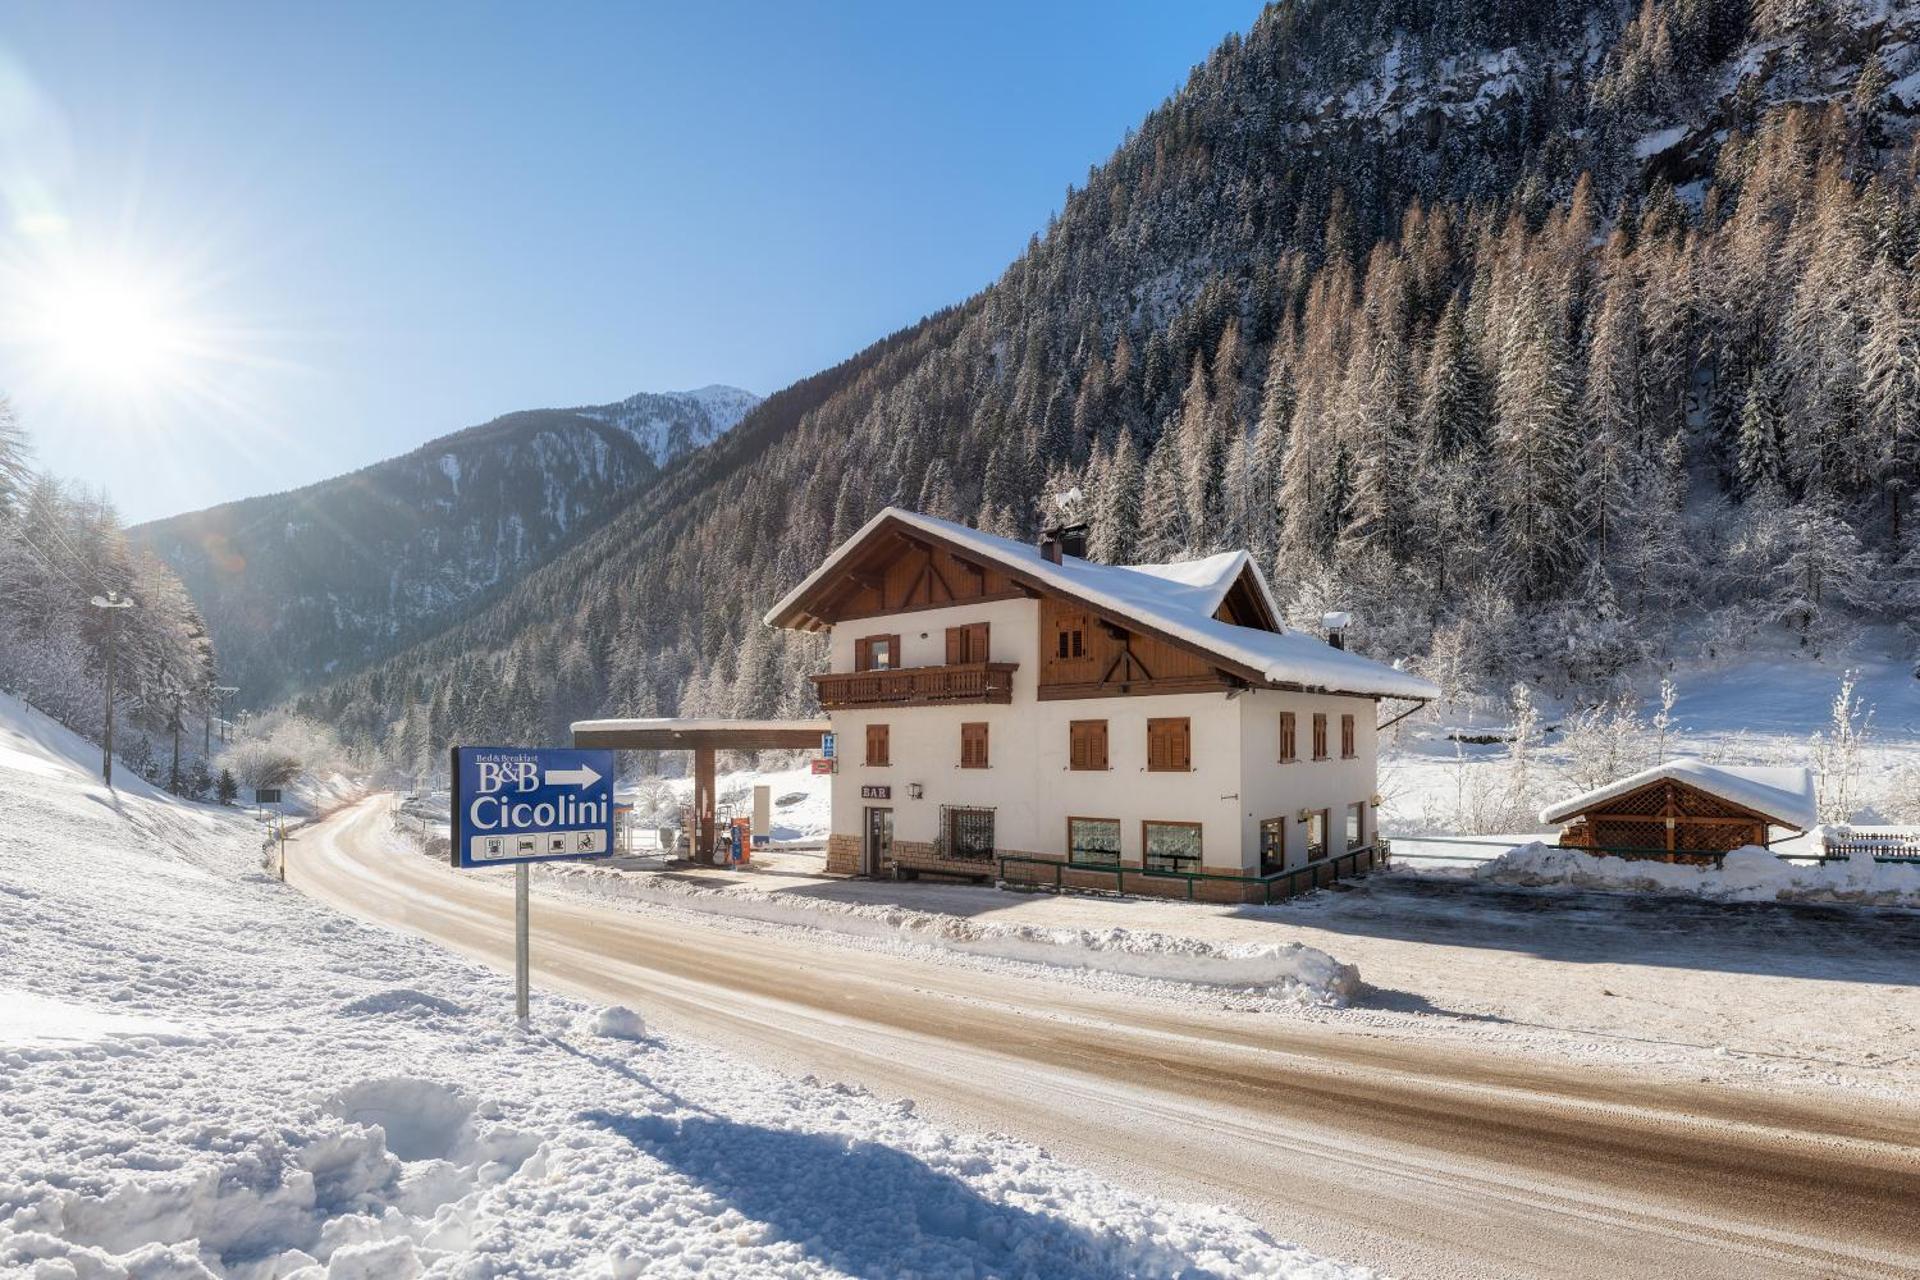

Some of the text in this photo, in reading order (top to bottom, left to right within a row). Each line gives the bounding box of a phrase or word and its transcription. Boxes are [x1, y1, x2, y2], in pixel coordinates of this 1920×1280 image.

[475, 762, 540, 793] B&B
[863, 788, 886, 798] BAR
[470, 793, 607, 830] Cicolini
